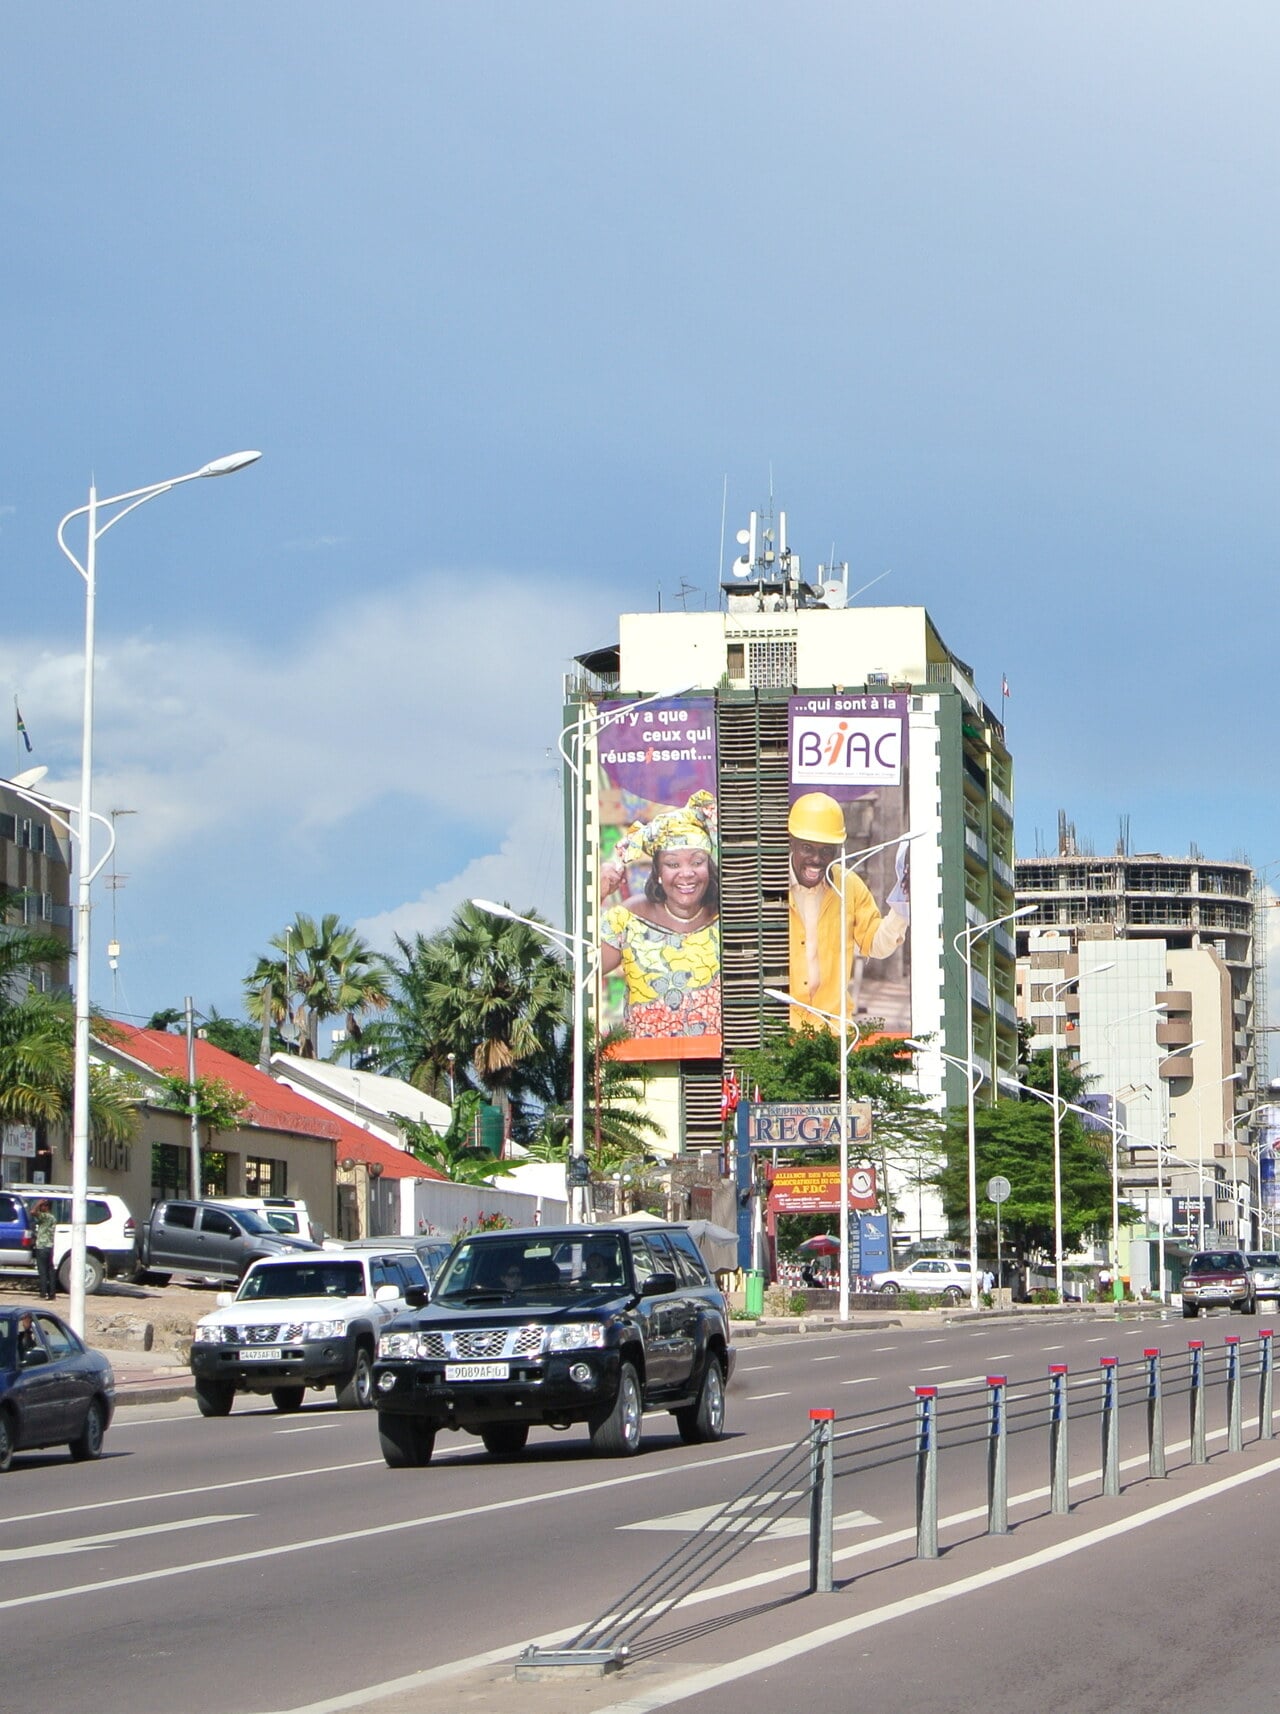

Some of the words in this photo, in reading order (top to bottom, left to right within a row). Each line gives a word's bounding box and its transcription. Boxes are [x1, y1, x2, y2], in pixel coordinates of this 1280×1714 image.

[834, 699, 867, 710] sont
[870, 697, 879, 710] à
[883, 697, 897, 710] la
[644, 711, 654, 723] a
[658, 710, 688, 725] que
[642, 730, 681, 742] ceux
[686, 726, 712, 744] qui
[755, 1115, 869, 1141] REGAL
